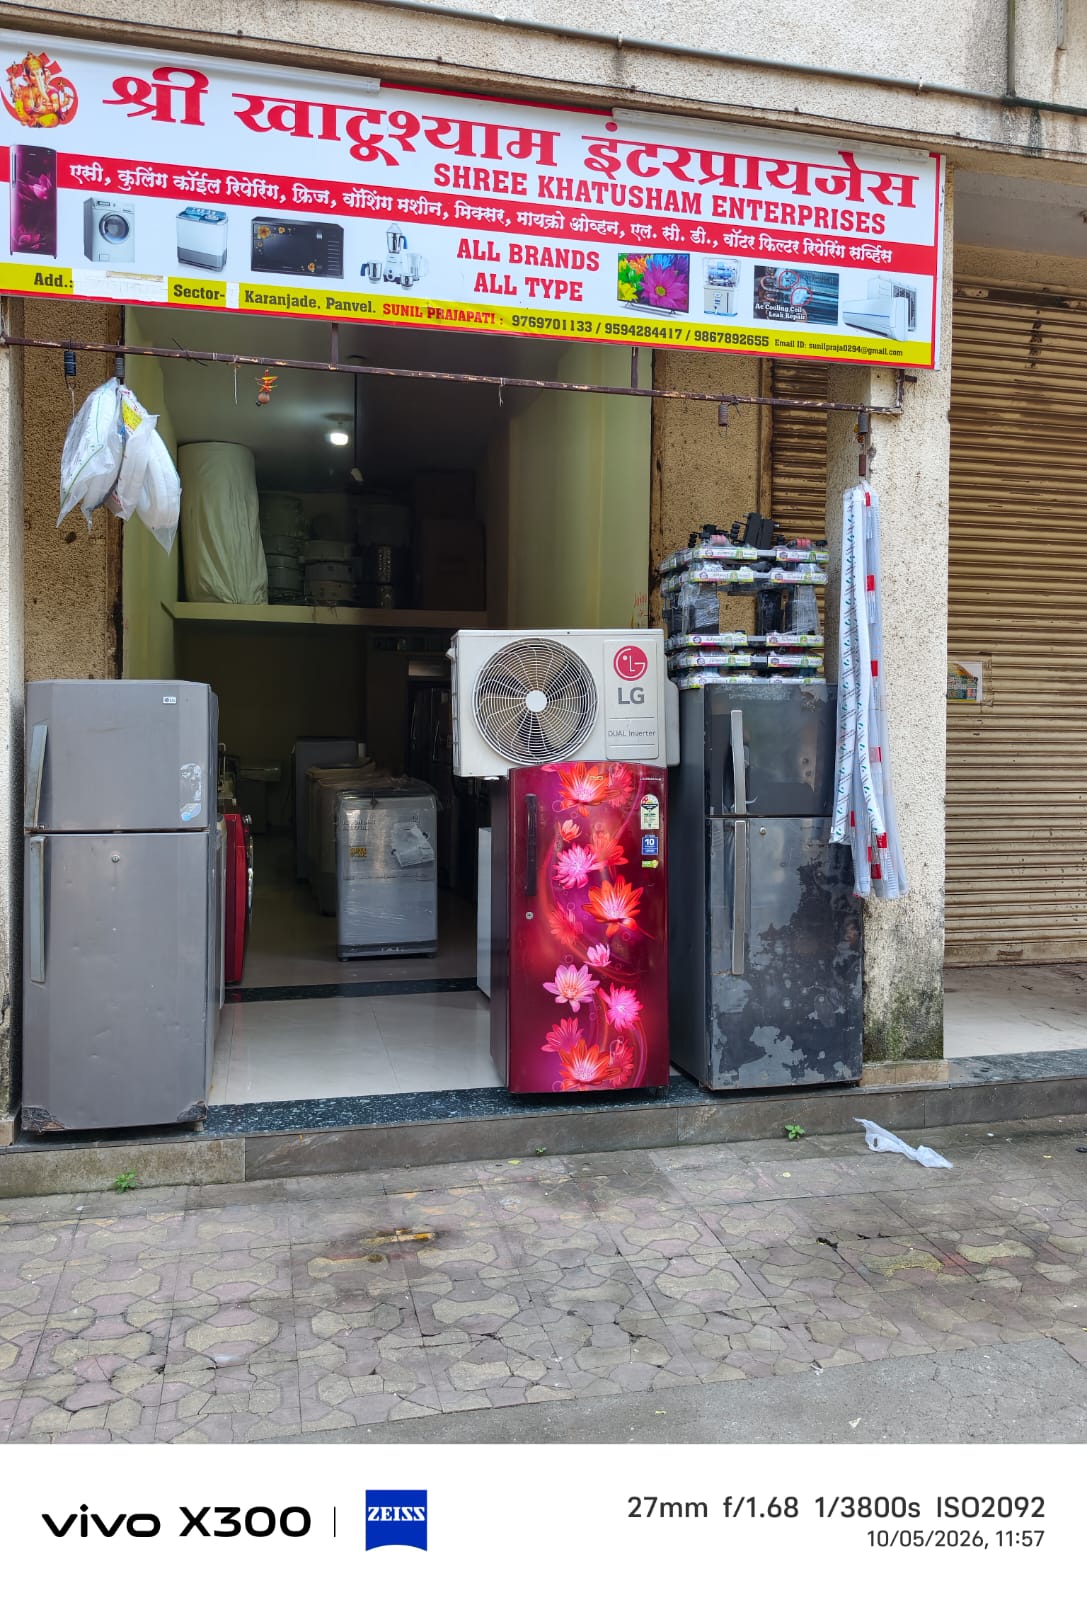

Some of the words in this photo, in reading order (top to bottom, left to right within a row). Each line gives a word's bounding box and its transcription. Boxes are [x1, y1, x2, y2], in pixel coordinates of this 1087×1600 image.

[102, 66, 209, 126] श्री
[232, 93, 560, 166] खाटूश्याम
[582, 121, 919, 209] इंटरप्रायजेस
[70, 162, 111, 186] एसी,
[117, 166, 168, 191] कुलिंग
[226, 176, 287, 204] रिपेरिंग,
[292, 182, 336, 208] फ्रिज,
[342, 187, 393, 212] वॉशिंग
[397, 195, 449, 220] मशीन,
[454, 199, 511, 227] मिक्सर,
[517, 210, 565, 230] मायक्रो
[433, 163, 527, 196] SHREE
[537, 174, 703, 215] KHATUSHAM
[711, 195, 886, 235] ENTERPRISES
[457, 238, 501, 261] ALL
[508, 243, 600, 272] BRANDS
[33, 272, 73, 288] Add.:
[173, 283, 225, 300] Sector-
[474, 272, 517, 296] ALL
[524, 276, 583, 302] TYPE
[326, 297, 376, 313] Panvel.
[383, 303, 423, 318] SUNIL
[427, 307, 496, 325] PRAJAPATI
[511, 314, 593, 333] 9769701133
[604, 322, 683, 339] 9594284417
[694, 331, 769, 347] 9867892655
[774, 339, 795, 349] Email
[809, 342, 903, 357] sunilpraja0294@gmail.com
[617, 687, 645, 705] LG
